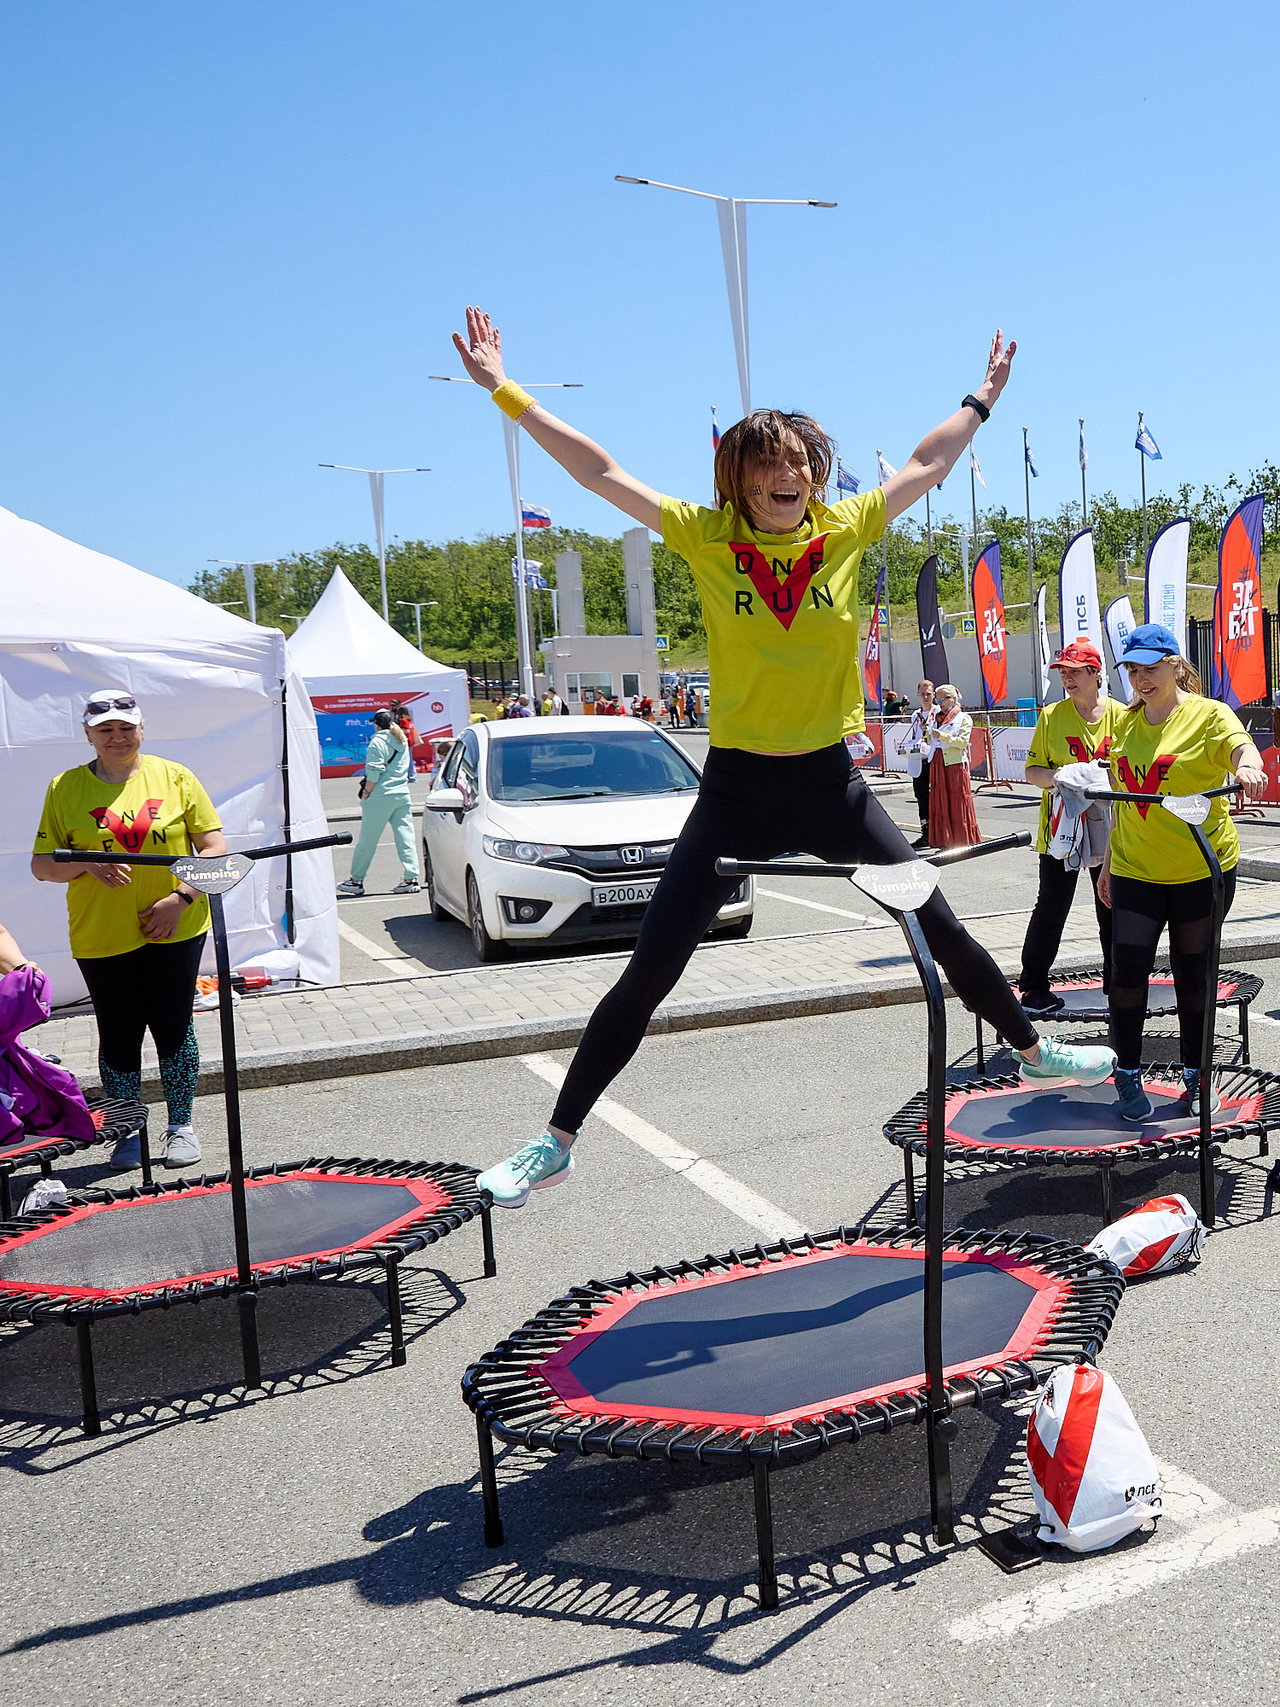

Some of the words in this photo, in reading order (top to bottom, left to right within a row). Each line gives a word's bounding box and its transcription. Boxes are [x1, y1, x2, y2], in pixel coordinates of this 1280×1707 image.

[735, 551, 824, 576] ONE
[735, 584, 834, 616] RUN
[1076, 595, 1089, 631] ПСБ
[1068, 743, 1111, 758] ONE
[1117, 764, 1170, 783] ONE
[95, 806, 161, 830] ONE
[102, 828, 168, 853] RUN
[176, 863, 194, 874] pro
[184, 866, 241, 882] Jumping
[859, 873, 879, 884] pro
[871, 878, 931, 895] Jumping
